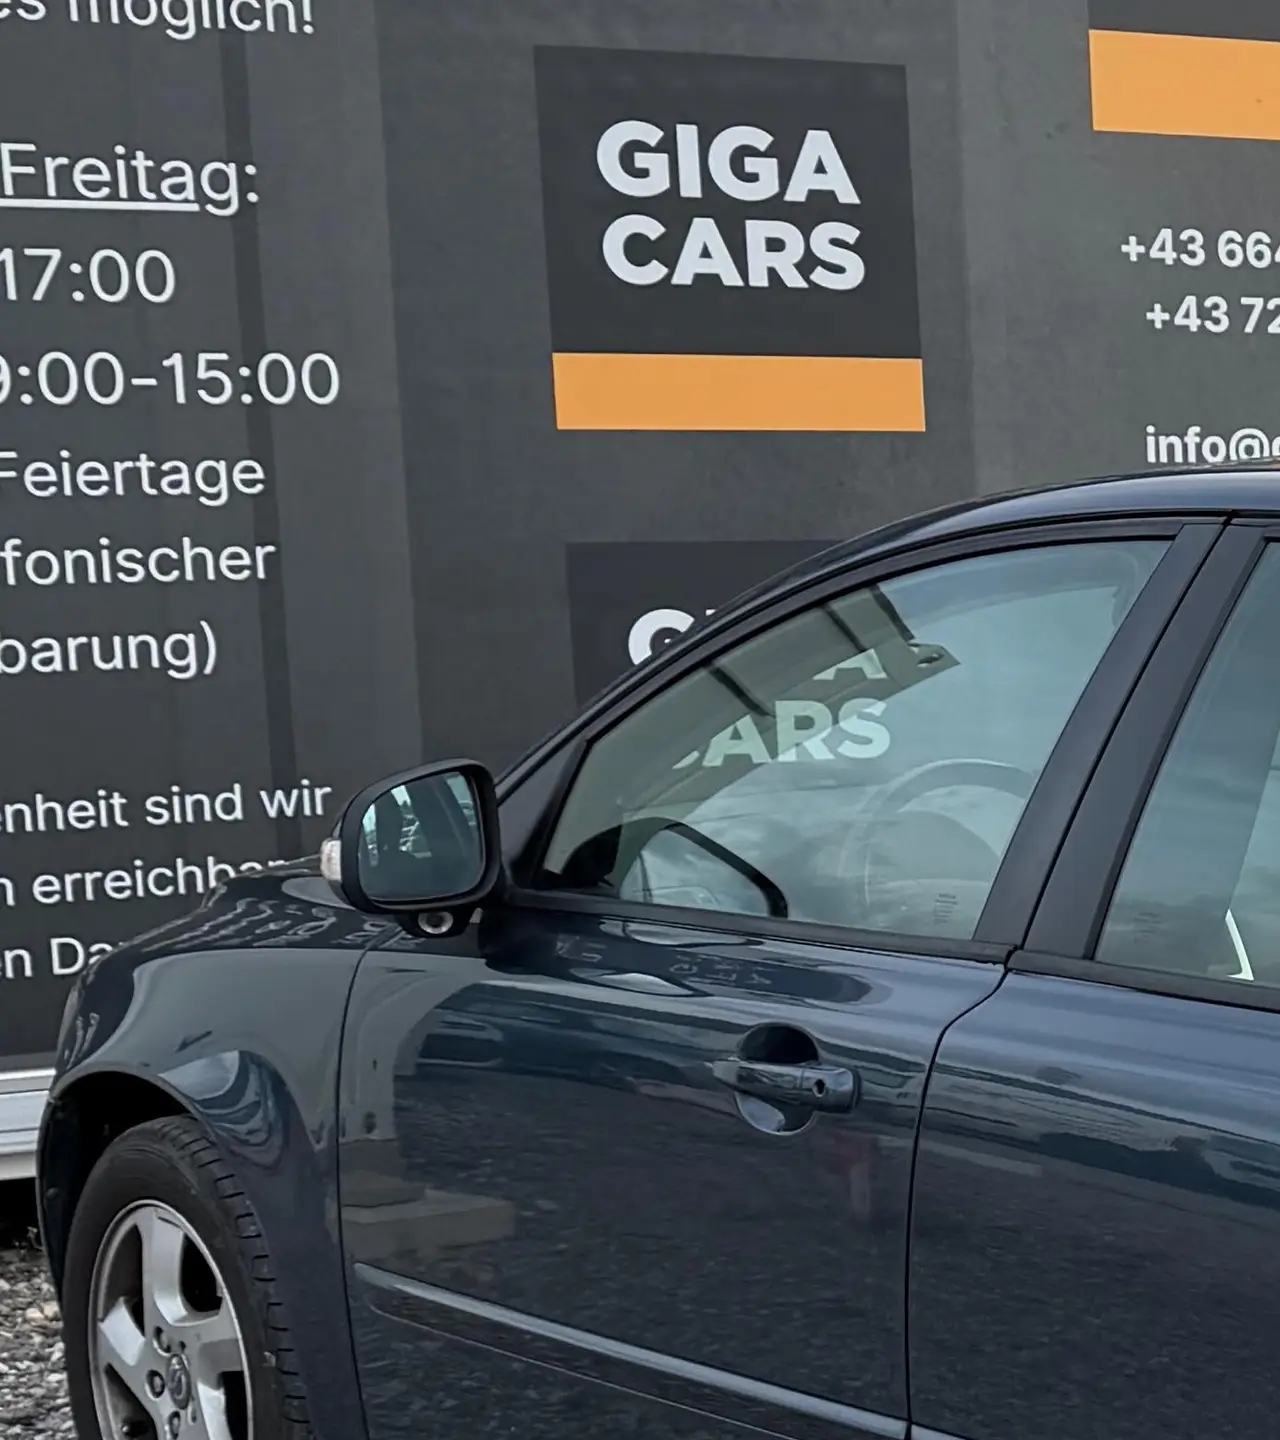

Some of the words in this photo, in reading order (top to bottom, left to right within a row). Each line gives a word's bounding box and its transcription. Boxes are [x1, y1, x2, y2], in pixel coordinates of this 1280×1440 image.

[0, 142, 259, 216] Freitag:
[596, 119, 861, 205] GIGA
[602, 213, 865, 291] CARS
[1120, 228, 1206, 267] +43
[1145, 295, 1230, 333] +43
[0, 536, 276, 586] fonischer
[672, 692, 892, 769] ARS
[0, 789, 129, 833] nheit
[145, 783, 244, 826] sind
[259, 778, 333, 819] wir
[32, 856, 286, 904] erreichb
